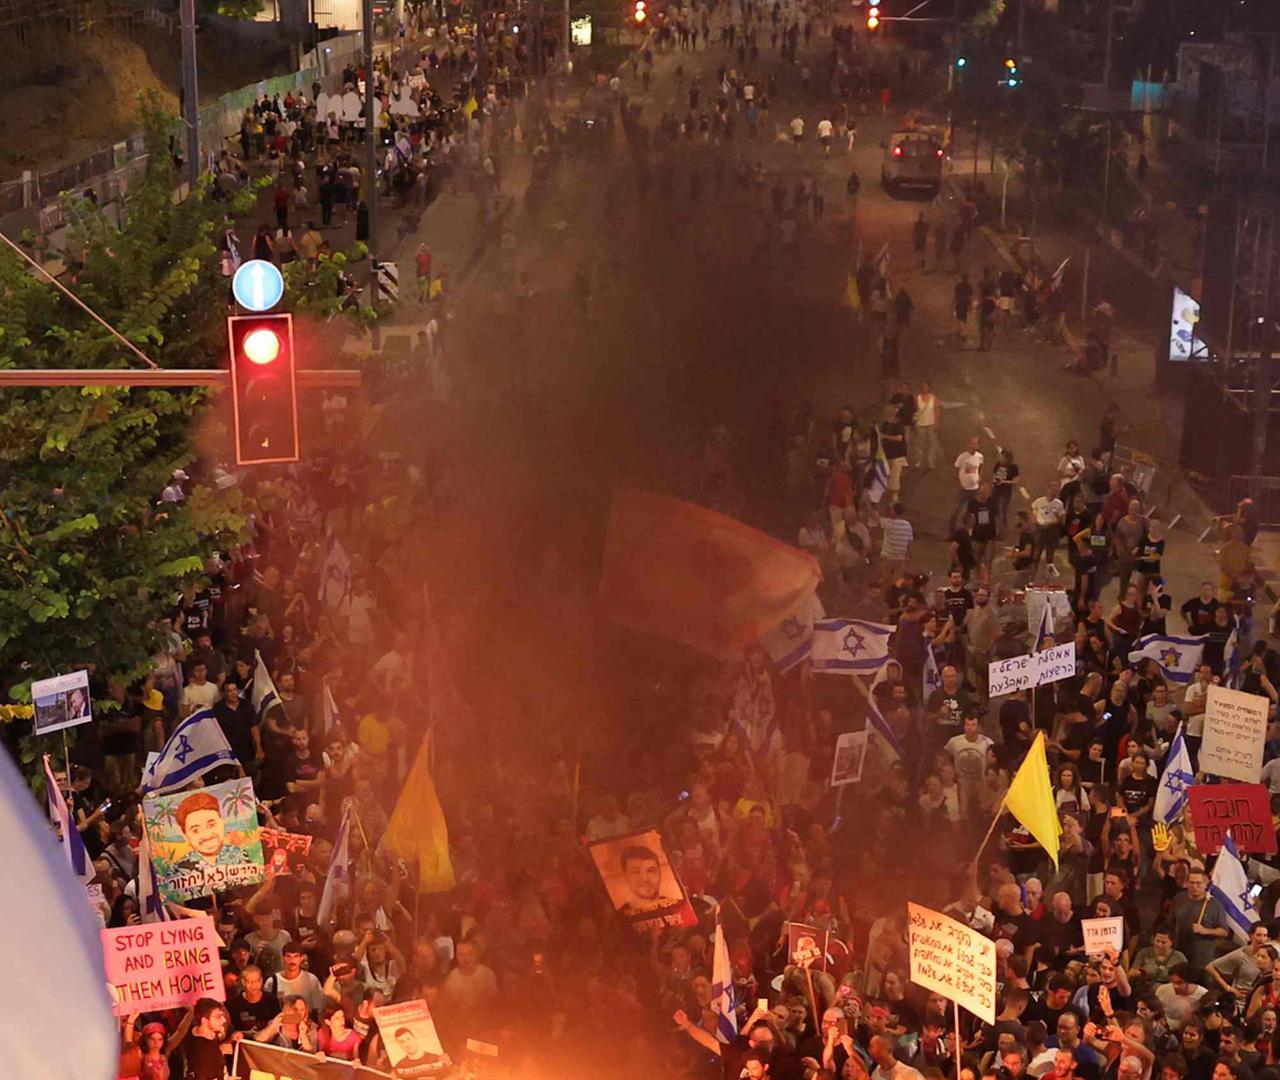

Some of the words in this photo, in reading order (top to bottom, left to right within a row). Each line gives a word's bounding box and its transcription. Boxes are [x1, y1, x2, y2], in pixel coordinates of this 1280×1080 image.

[1202, 798, 1251, 818] חובה
[115, 931, 153, 951] STOP
[160, 927, 204, 945] LYING
[125, 954, 154, 972] AND
[164, 947, 210, 969] BRING
[116, 980, 164, 1001] THEM
[169, 972, 215, 995] HOME
